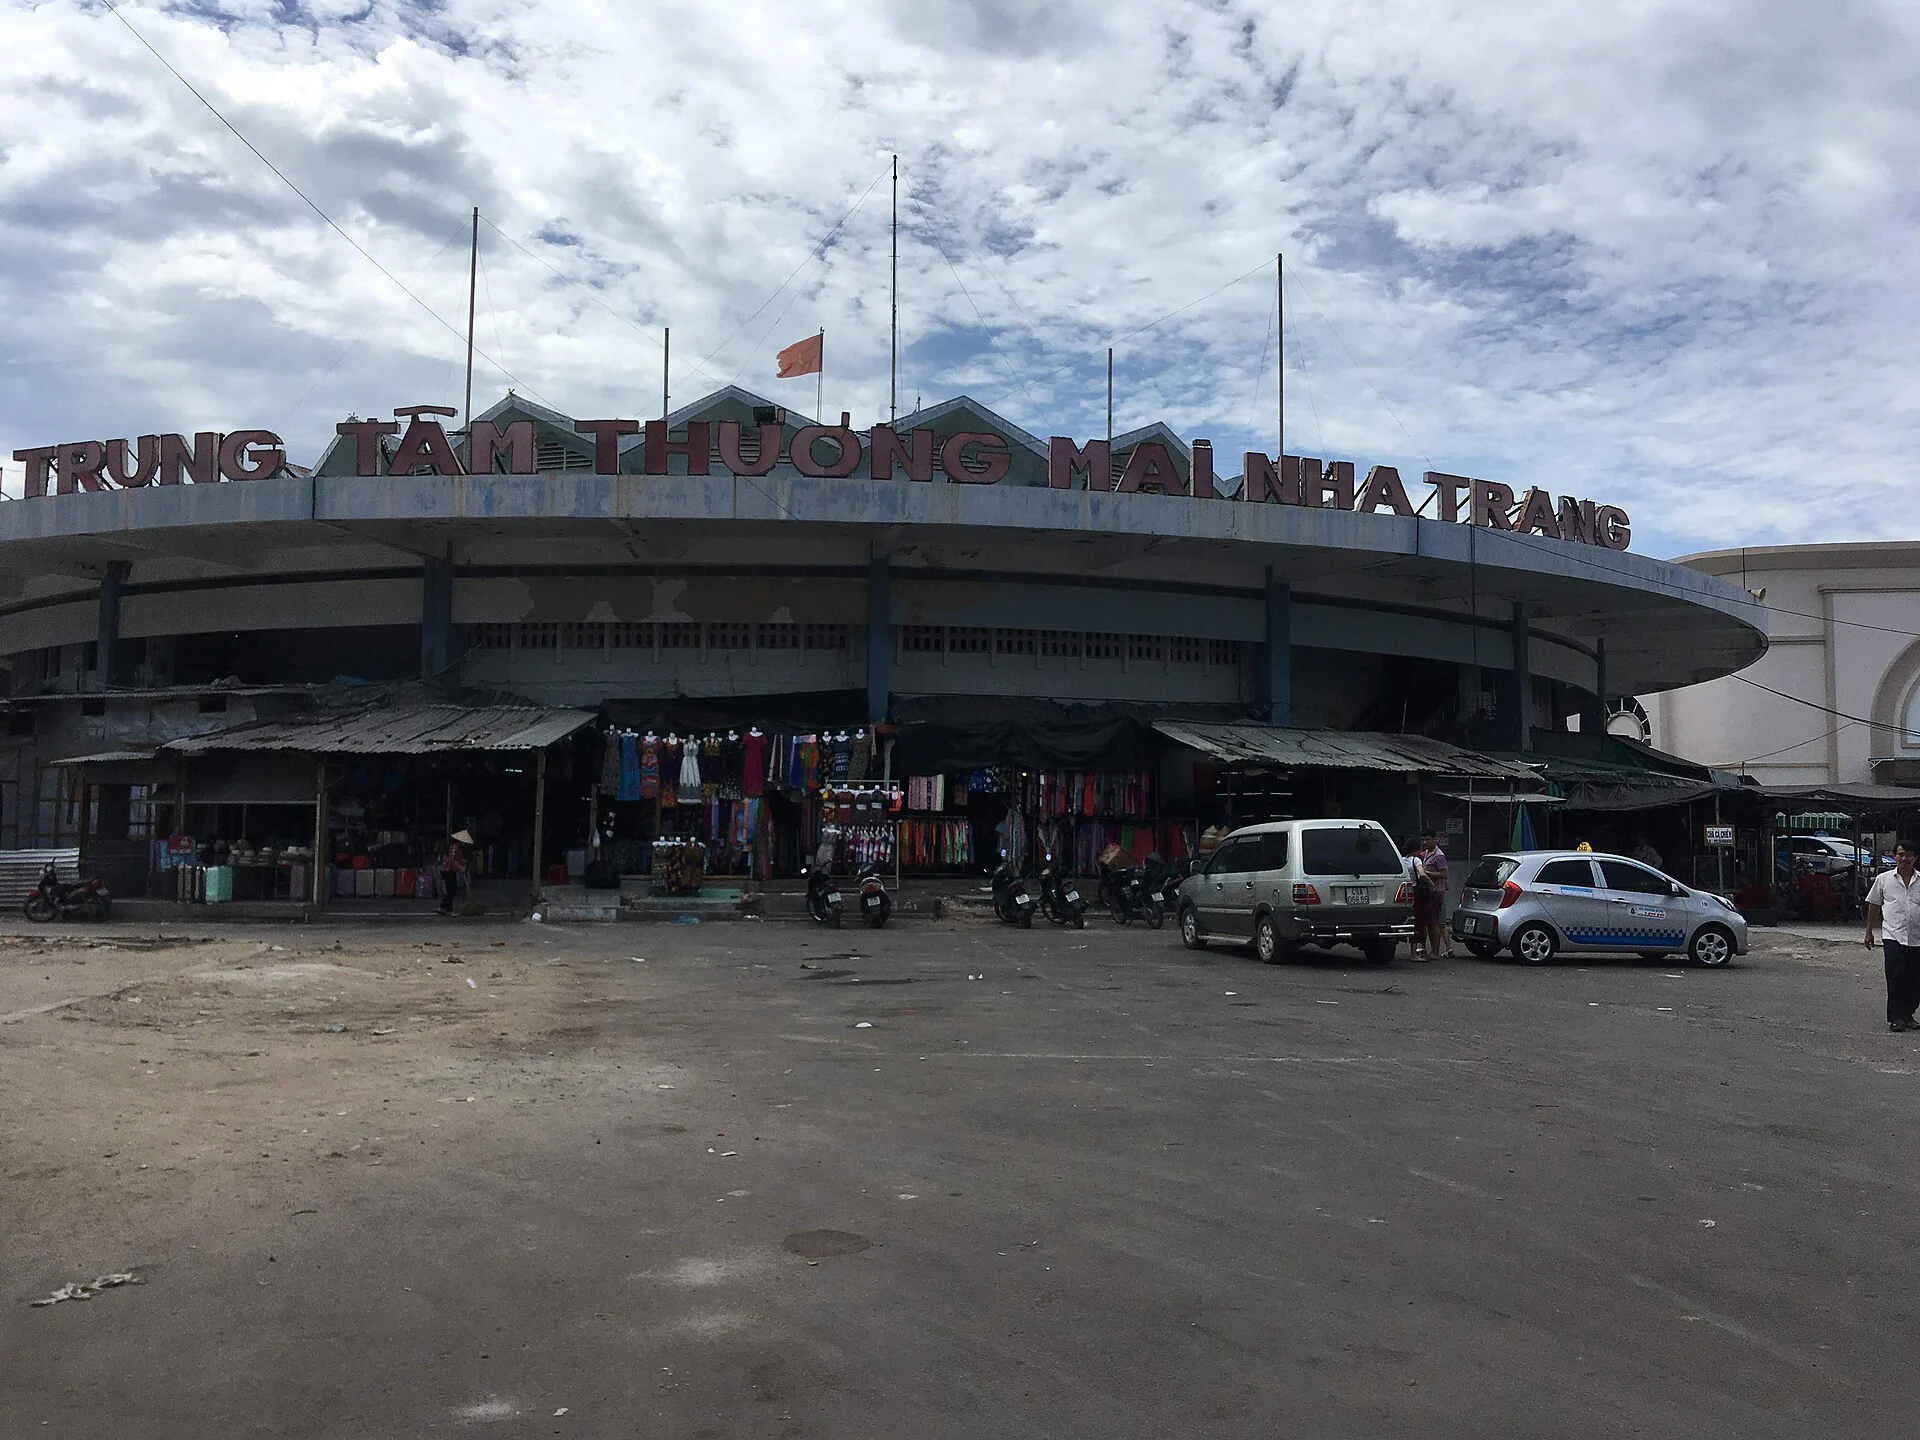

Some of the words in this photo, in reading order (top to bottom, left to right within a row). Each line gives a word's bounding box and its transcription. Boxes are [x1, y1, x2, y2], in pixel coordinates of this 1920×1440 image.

[13, 430, 286, 499] TRUNG
[337, 405, 537, 476] TÂM
[1244, 452, 1415, 516] NHA
[1423, 471, 1631, 550] TRANG
